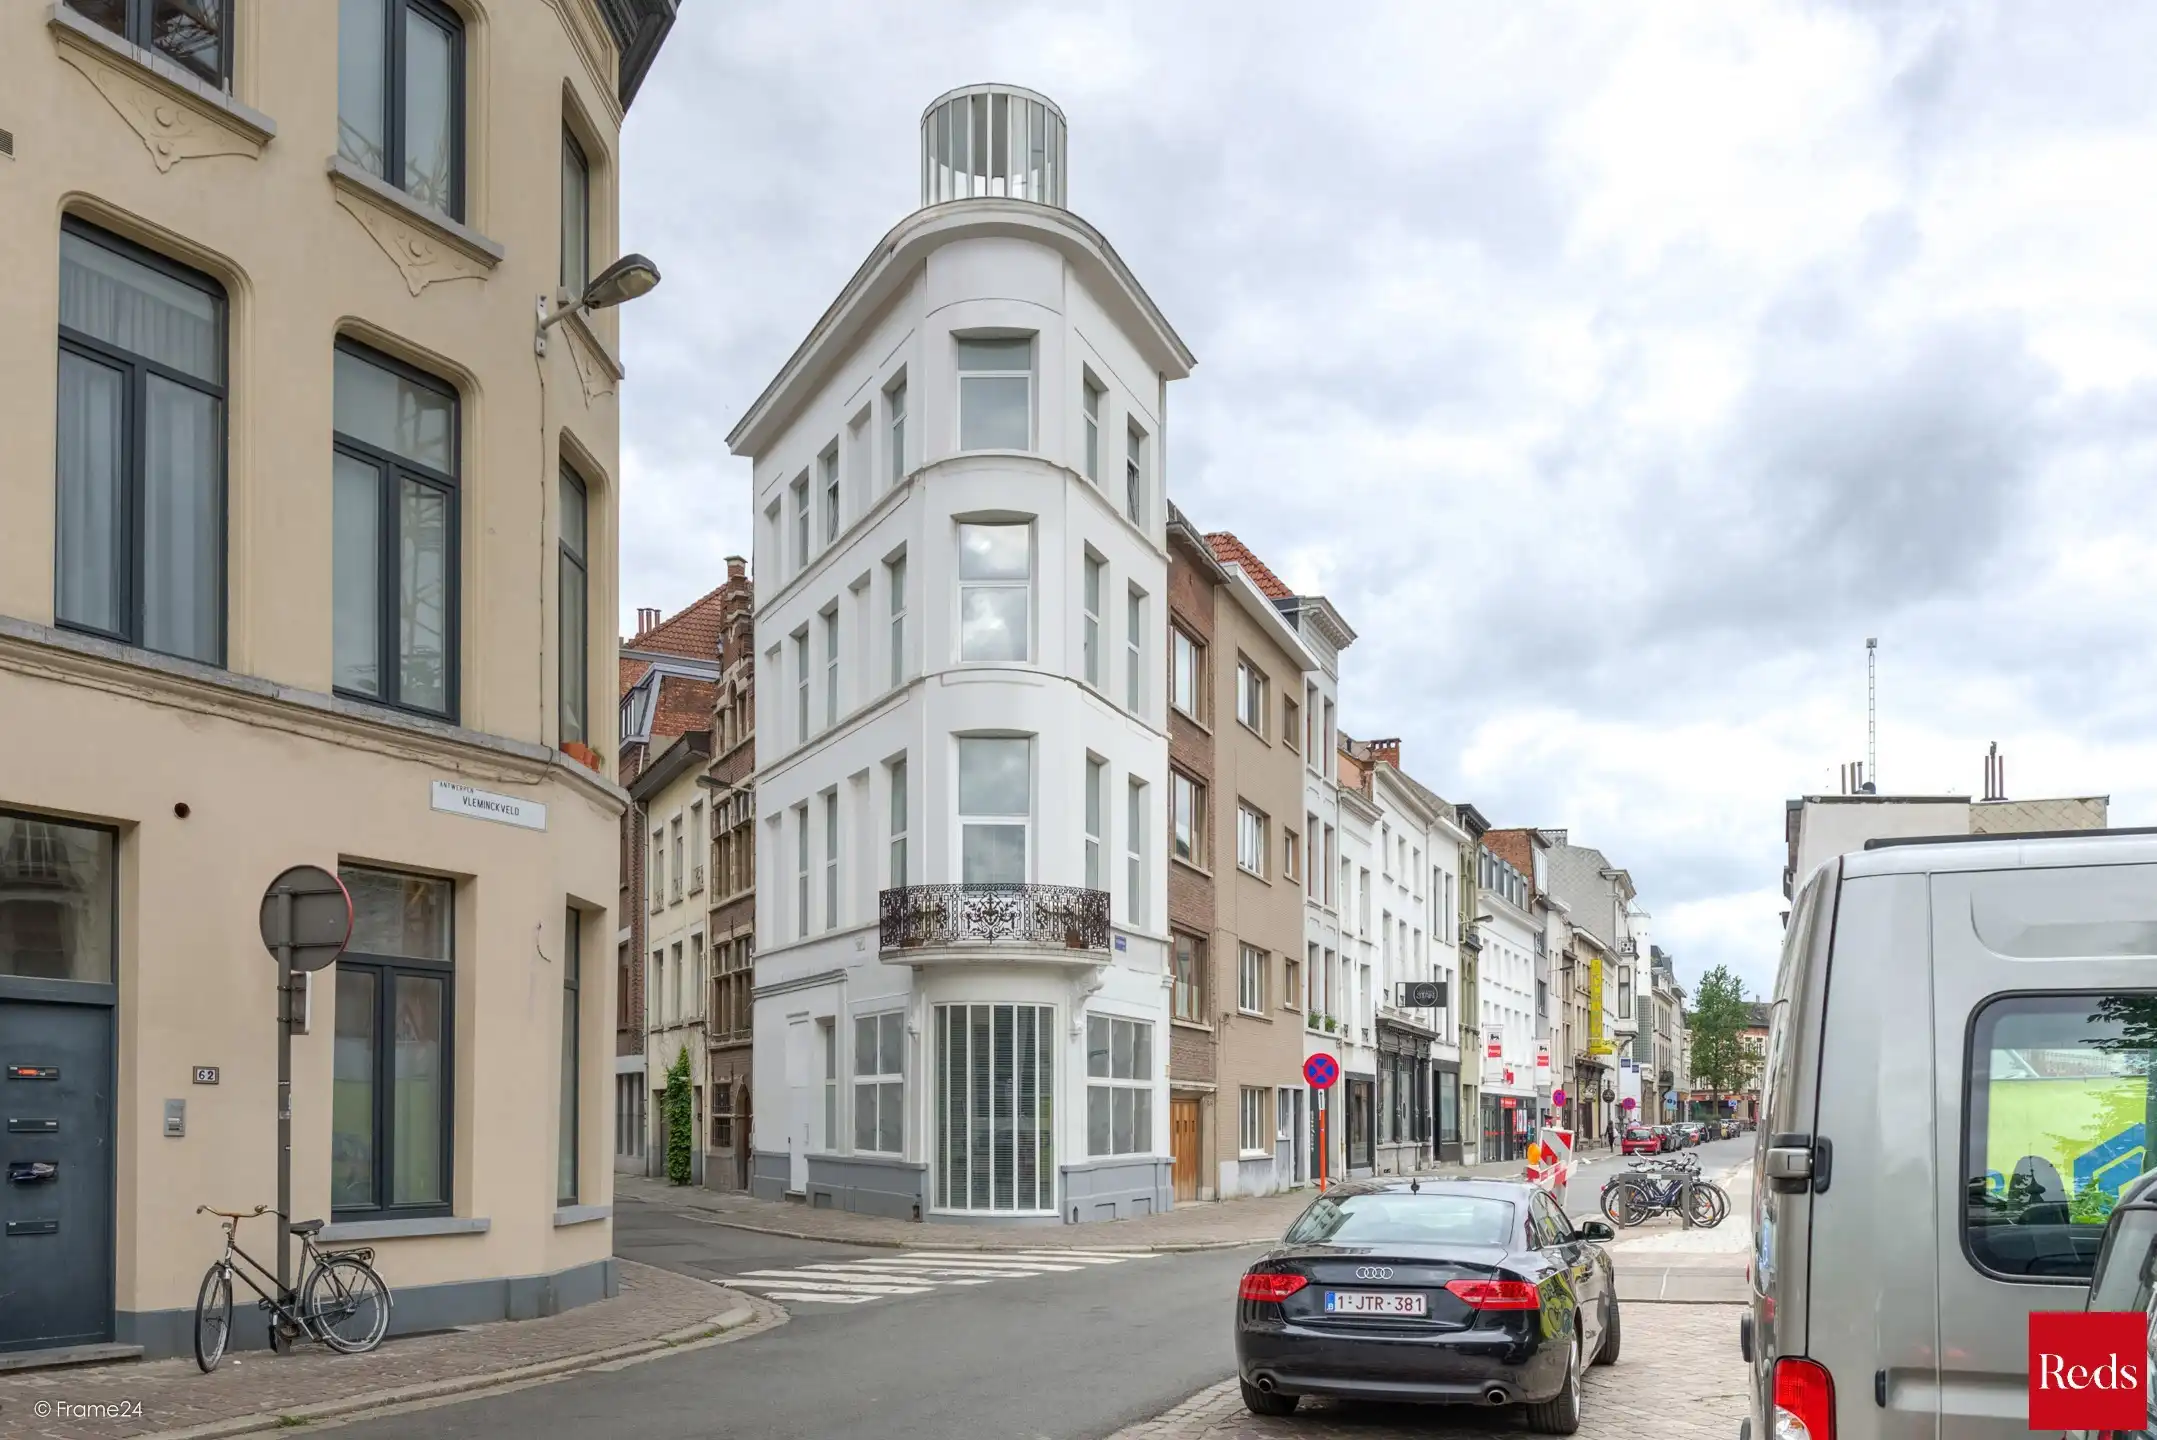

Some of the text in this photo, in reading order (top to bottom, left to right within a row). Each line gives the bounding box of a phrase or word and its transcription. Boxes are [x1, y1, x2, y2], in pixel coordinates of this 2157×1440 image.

[439, 781, 474, 794] ANTWERPEN
[462, 796, 520, 816] VLEMINCKVELD
[198, 1070, 214, 1080] 62
[1337, 1295, 1423, 1312] 1-JTR-381
